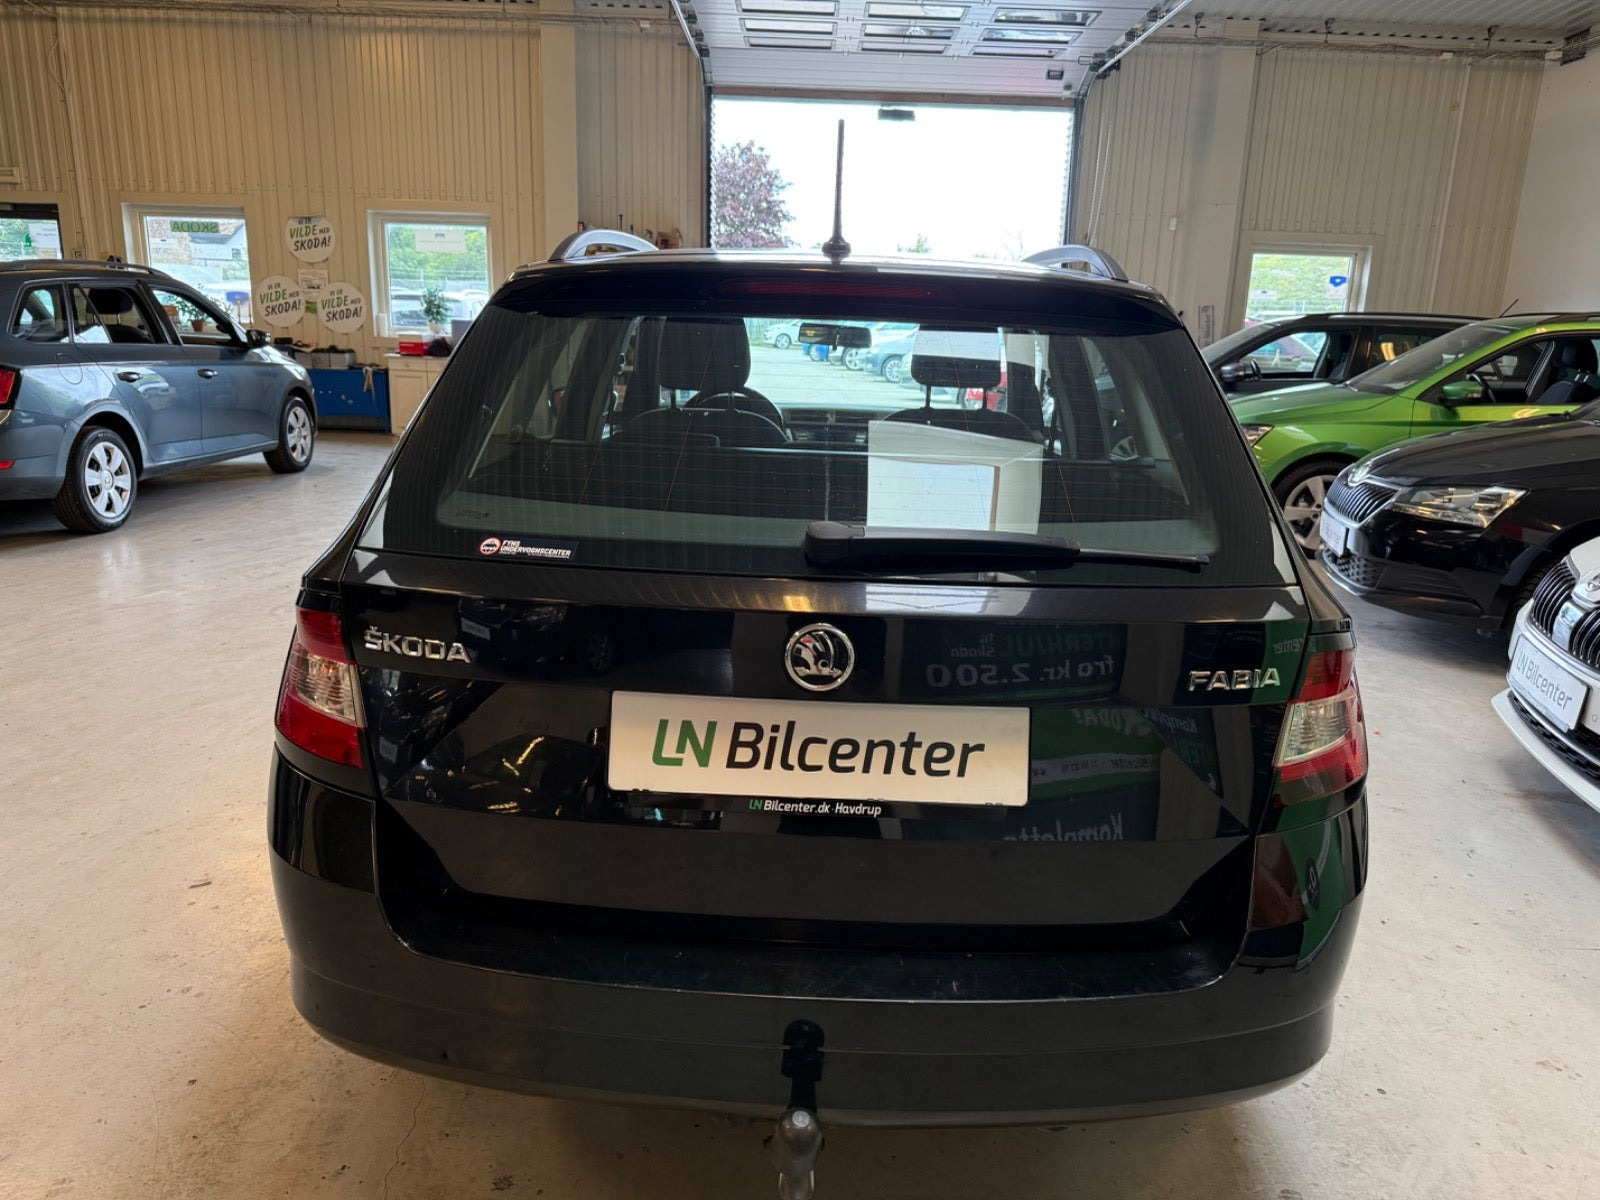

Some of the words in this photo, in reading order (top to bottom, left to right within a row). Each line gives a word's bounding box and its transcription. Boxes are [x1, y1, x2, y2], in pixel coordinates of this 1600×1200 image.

[289, 225, 318, 239] VILDE
[293, 236, 332, 252] SKODA!
[259, 289, 288, 304] VILDE
[321, 295, 350, 310] VILDE
[264, 299, 302, 317] SKODA!
[325, 306, 363, 323] SKODA!
[363, 624, 471, 663] ŠKODA
[1189, 667, 1281, 691] FABIA
[1526, 660, 1573, 710] Bilcenter
[651, 718, 718, 768] LN
[725, 720, 985, 778] Bilcenter
[834, 802, 882, 818] Havdrup
